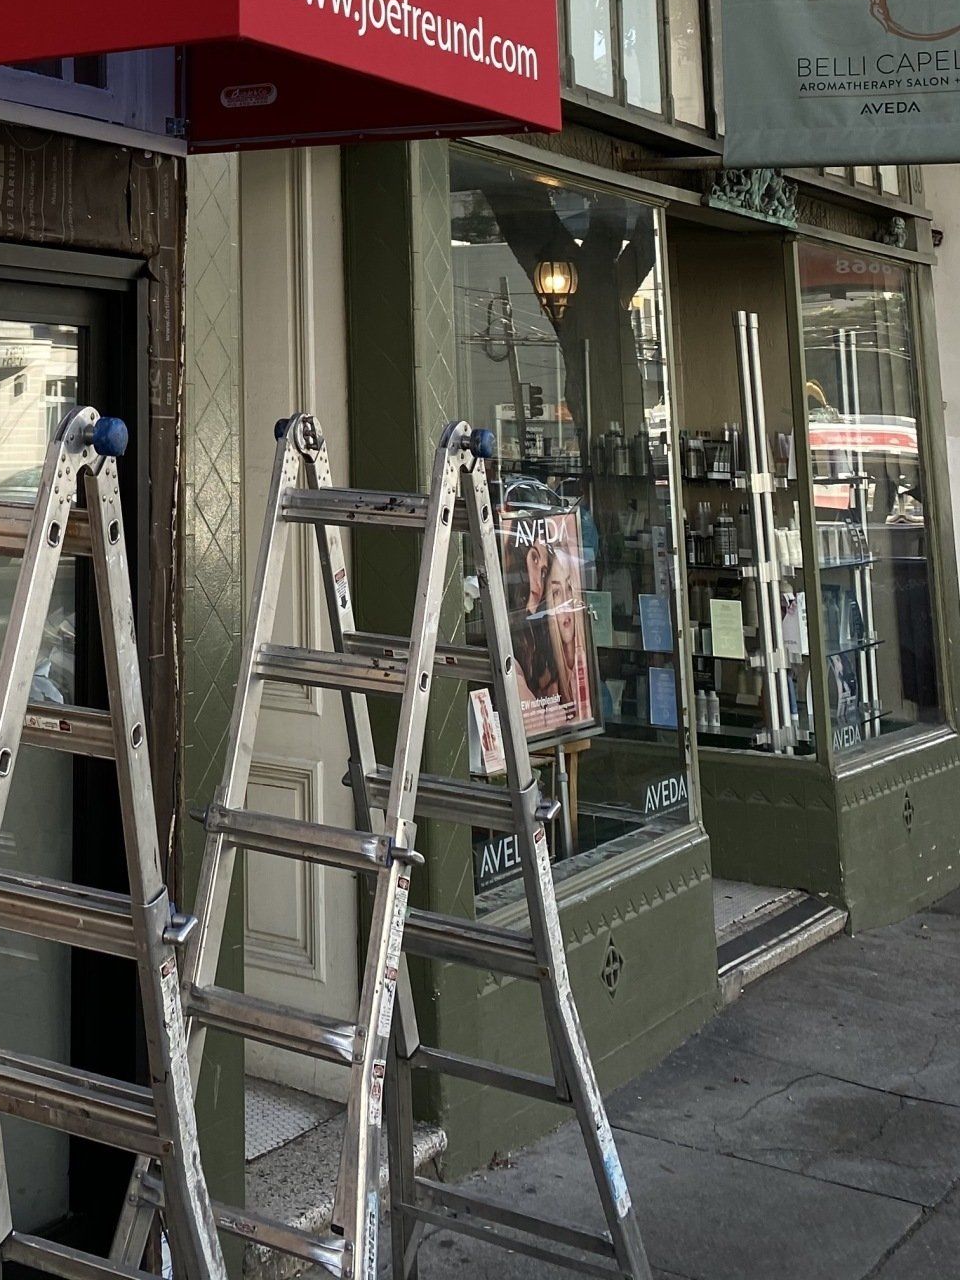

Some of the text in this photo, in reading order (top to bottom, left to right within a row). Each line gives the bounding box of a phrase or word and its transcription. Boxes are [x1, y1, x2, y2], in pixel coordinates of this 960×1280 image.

[797, 55, 866, 78] BELLI
[799, 78, 902, 92] AROMATHERAPY
[906, 76, 949, 88] SALON
[860, 101, 921, 115] AVEDA
[514, 517, 570, 549] AVEDA
[832, 723, 862, 751] AVEDA
[644, 773, 688, 814] AVEDA
